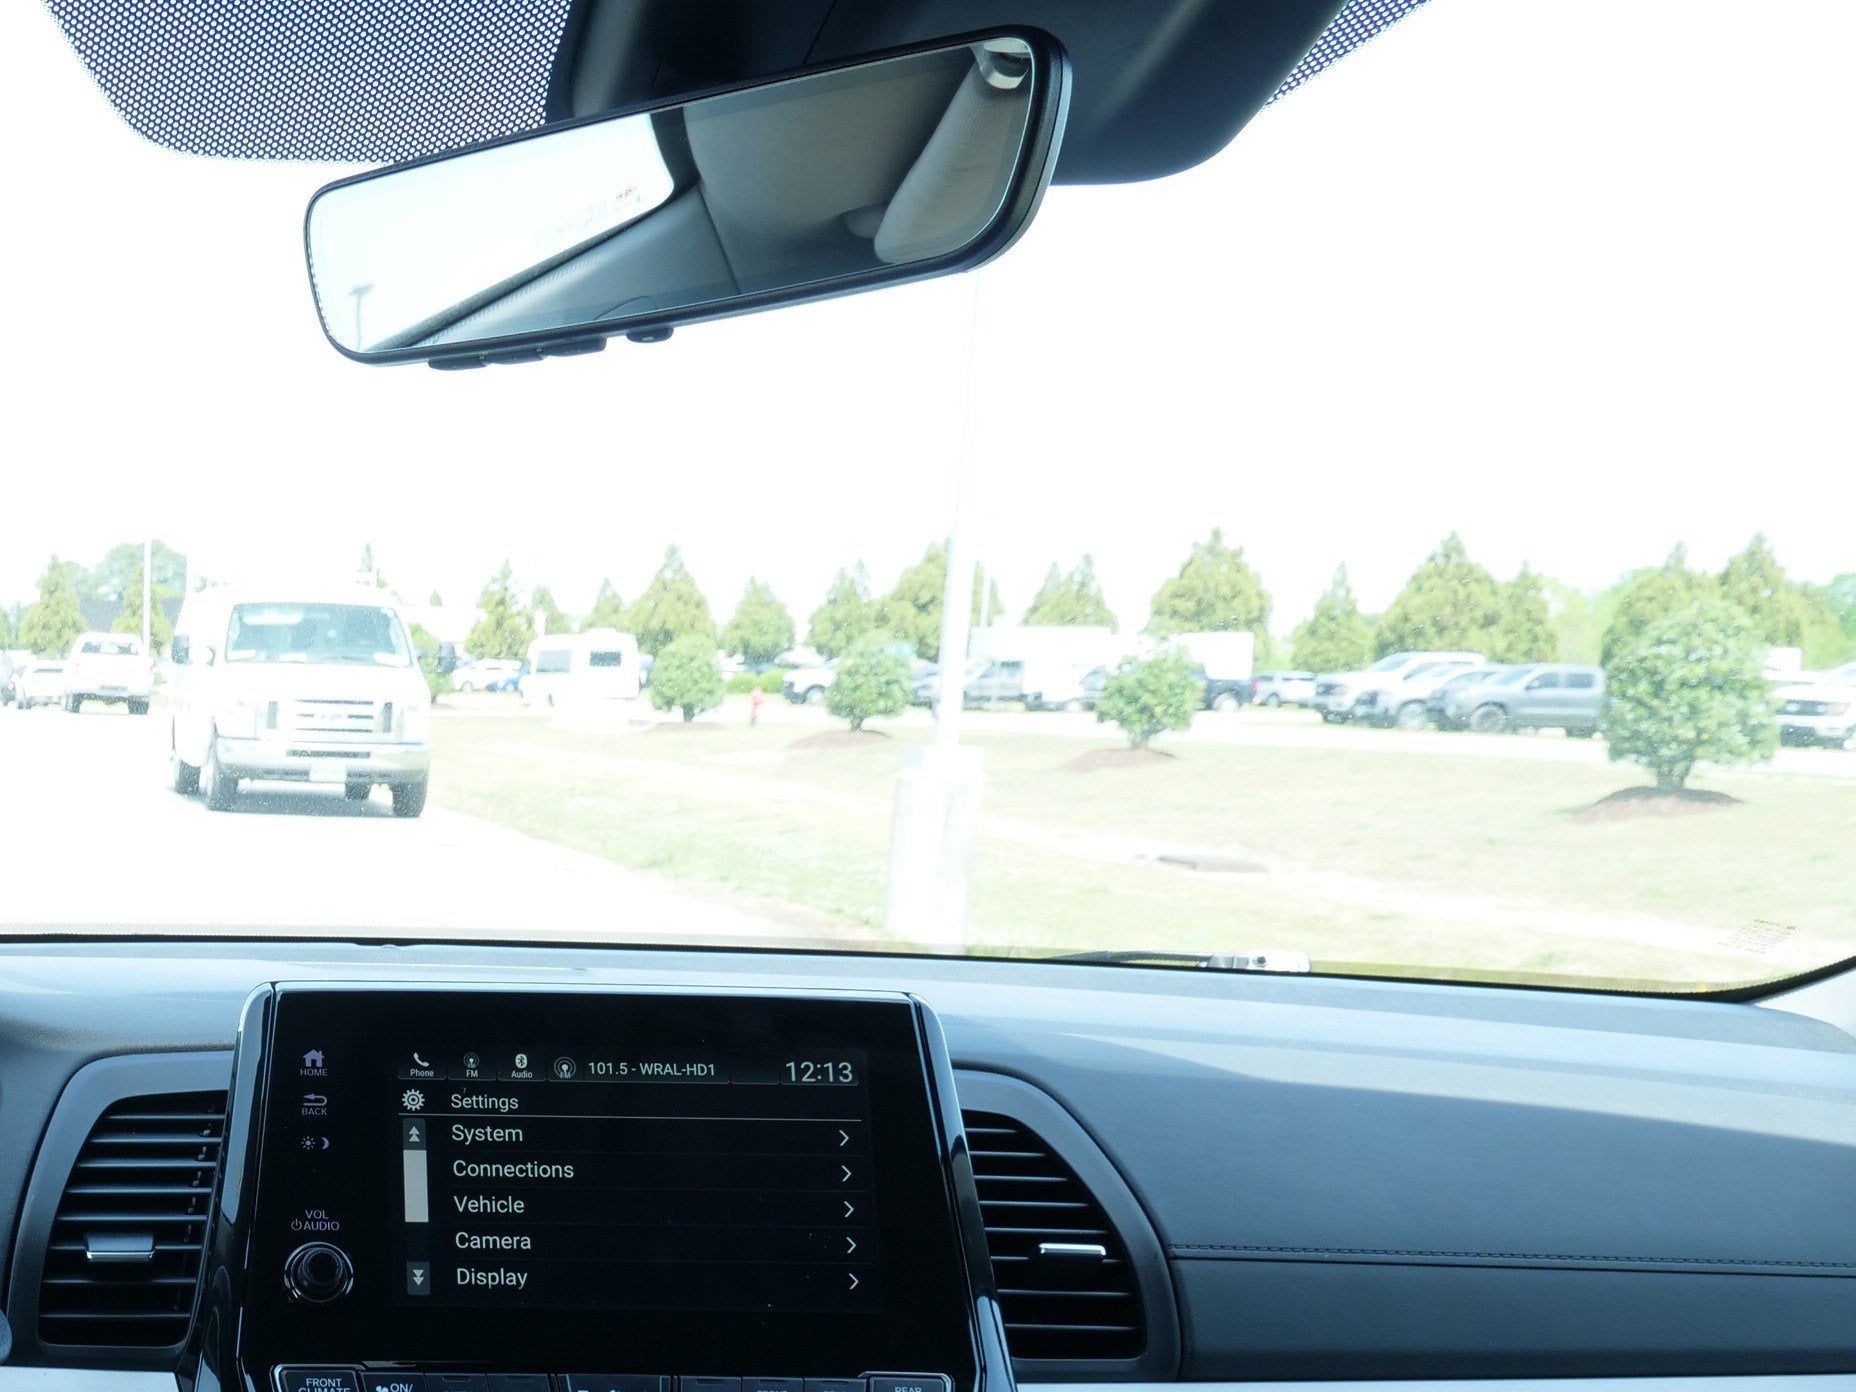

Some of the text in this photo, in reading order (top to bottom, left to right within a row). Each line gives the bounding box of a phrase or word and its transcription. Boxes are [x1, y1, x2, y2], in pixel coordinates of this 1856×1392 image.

[300, 1068, 328, 1077] HOME
[410, 1068, 434, 1078] Phone
[466, 1069, 478, 1078] FM
[511, 1069, 533, 1079] Audio
[588, 1062, 628, 1075] 101.5
[639, 1062, 715, 1076] WRAL-HD1
[785, 1061, 853, 1083] 12:13
[450, 1093, 519, 1113] Settings
[301, 1107, 328, 1116] BACK
[451, 1124, 523, 1145] System
[453, 1160, 574, 1178] Connections
[453, 1195, 525, 1213] Vehicle
[305, 1209, 329, 1220] VOL
[303, 1221, 340, 1231] AUDIO
[455, 1232, 532, 1250] Camera
[456, 1267, 528, 1289] Display
[306, 1378, 342, 1387] FRONT
